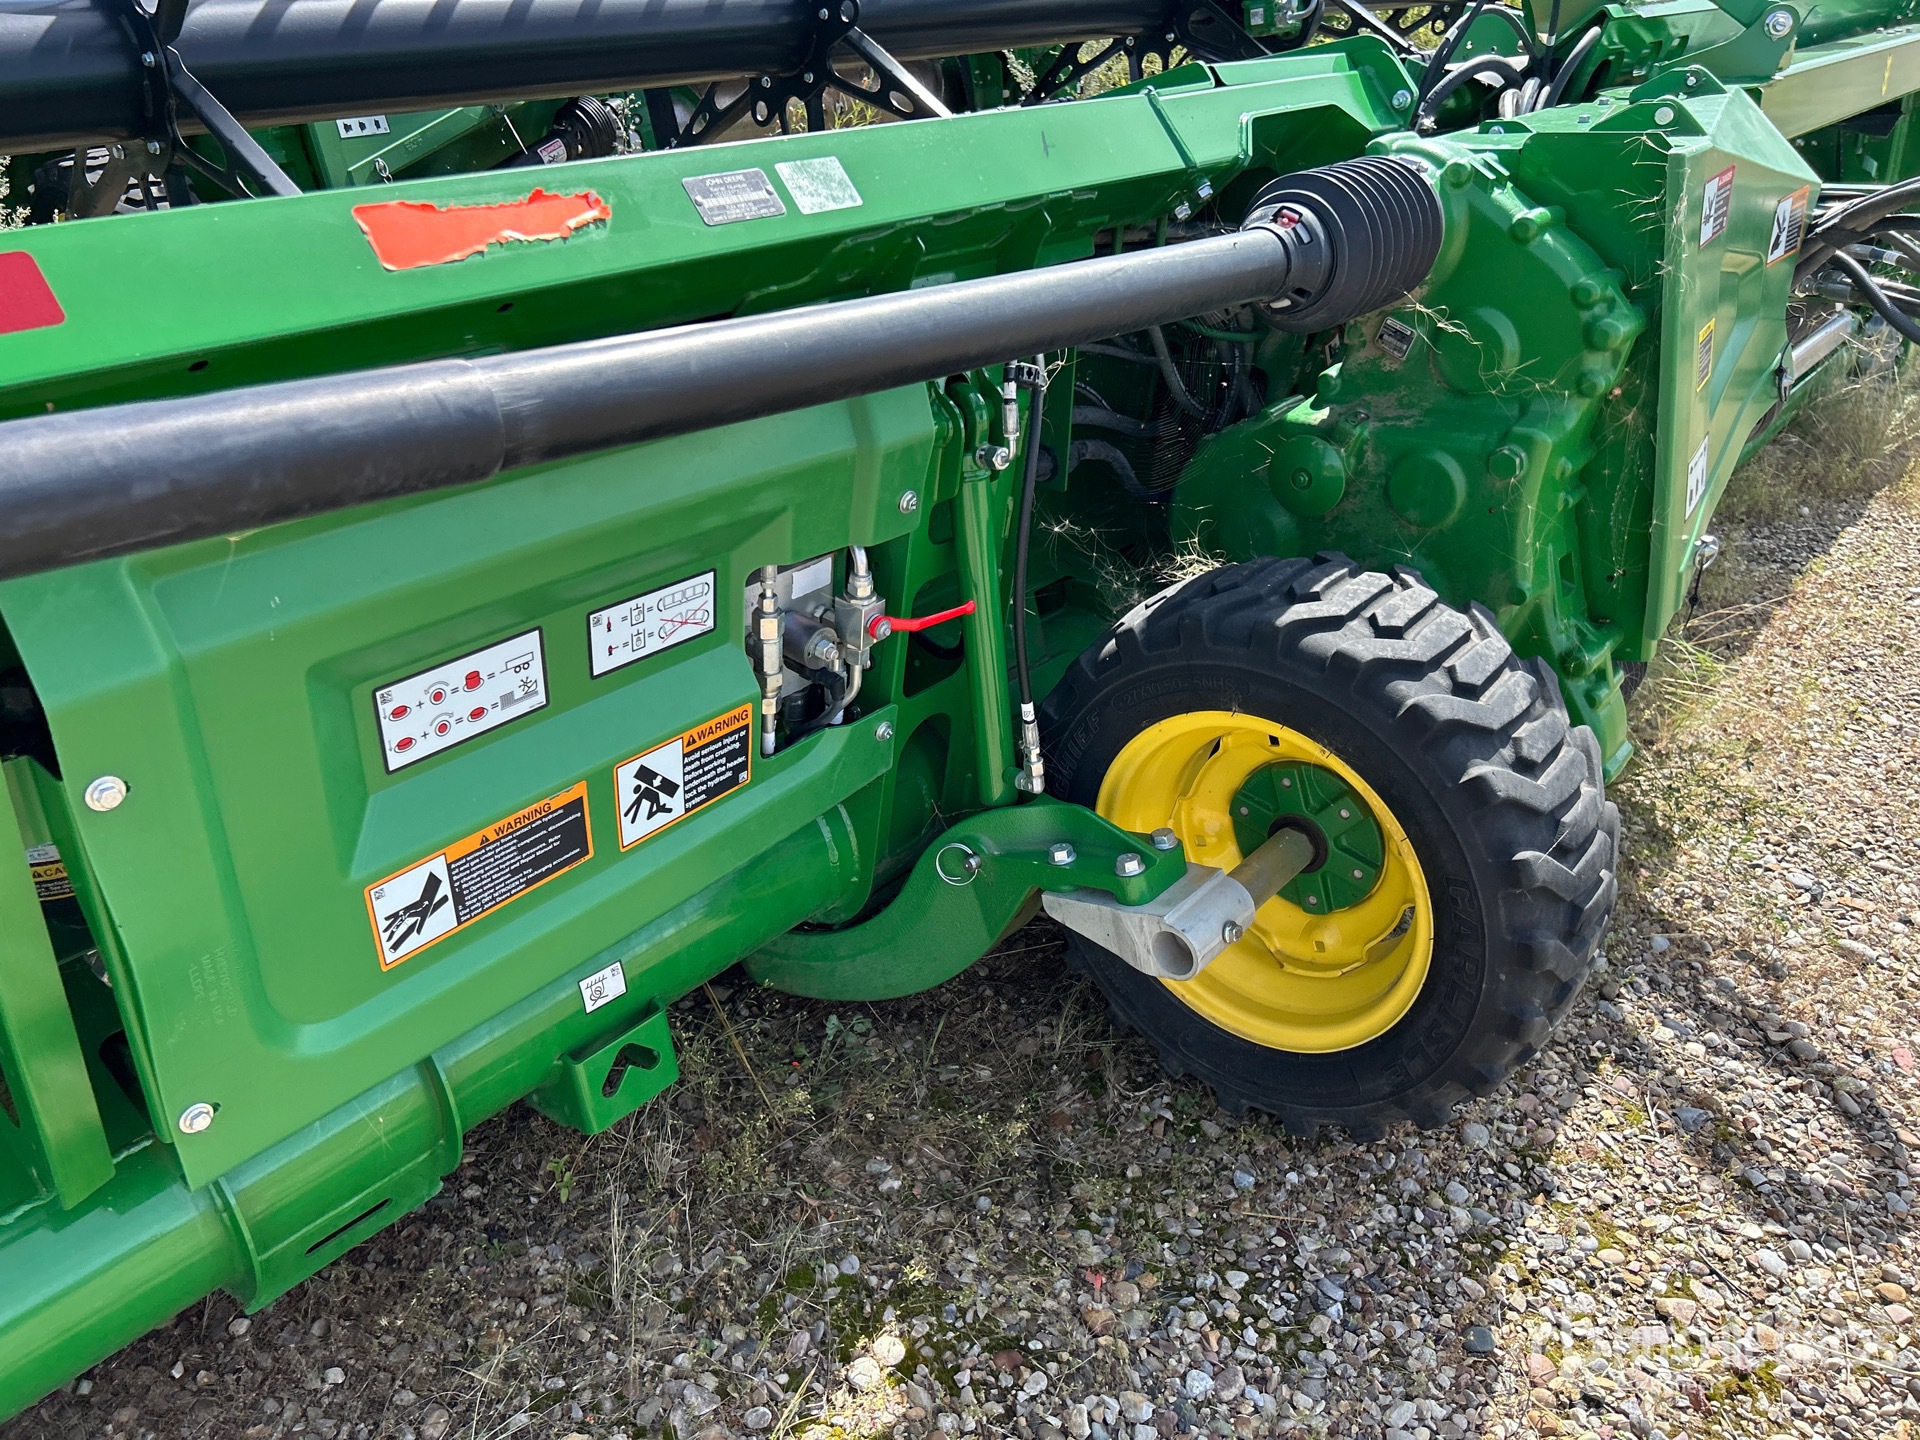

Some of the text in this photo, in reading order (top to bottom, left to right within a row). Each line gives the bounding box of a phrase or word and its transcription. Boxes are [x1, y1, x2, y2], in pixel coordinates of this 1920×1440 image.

[696, 709, 748, 740] WARNING
[683, 750, 700, 764] Avoid
[700, 741, 722, 755] serious
[722, 733, 739, 744] injury
[683, 741, 740, 772] death from crushing.
[684, 756, 726, 781] Before working
[684, 755, 746, 790] underneath the header.
[684, 770, 732, 799] lock the hydraulic
[685, 793, 707, 808] system.
[494, 802, 551, 836] WARNING
[450, 858, 465, 868] Avoid
[466, 848, 485, 860] serious
[485, 841, 500, 851] injury
[500, 835, 512, 843] from
[512, 825, 531, 837] contact
[541, 808, 563, 822] hydraulic
